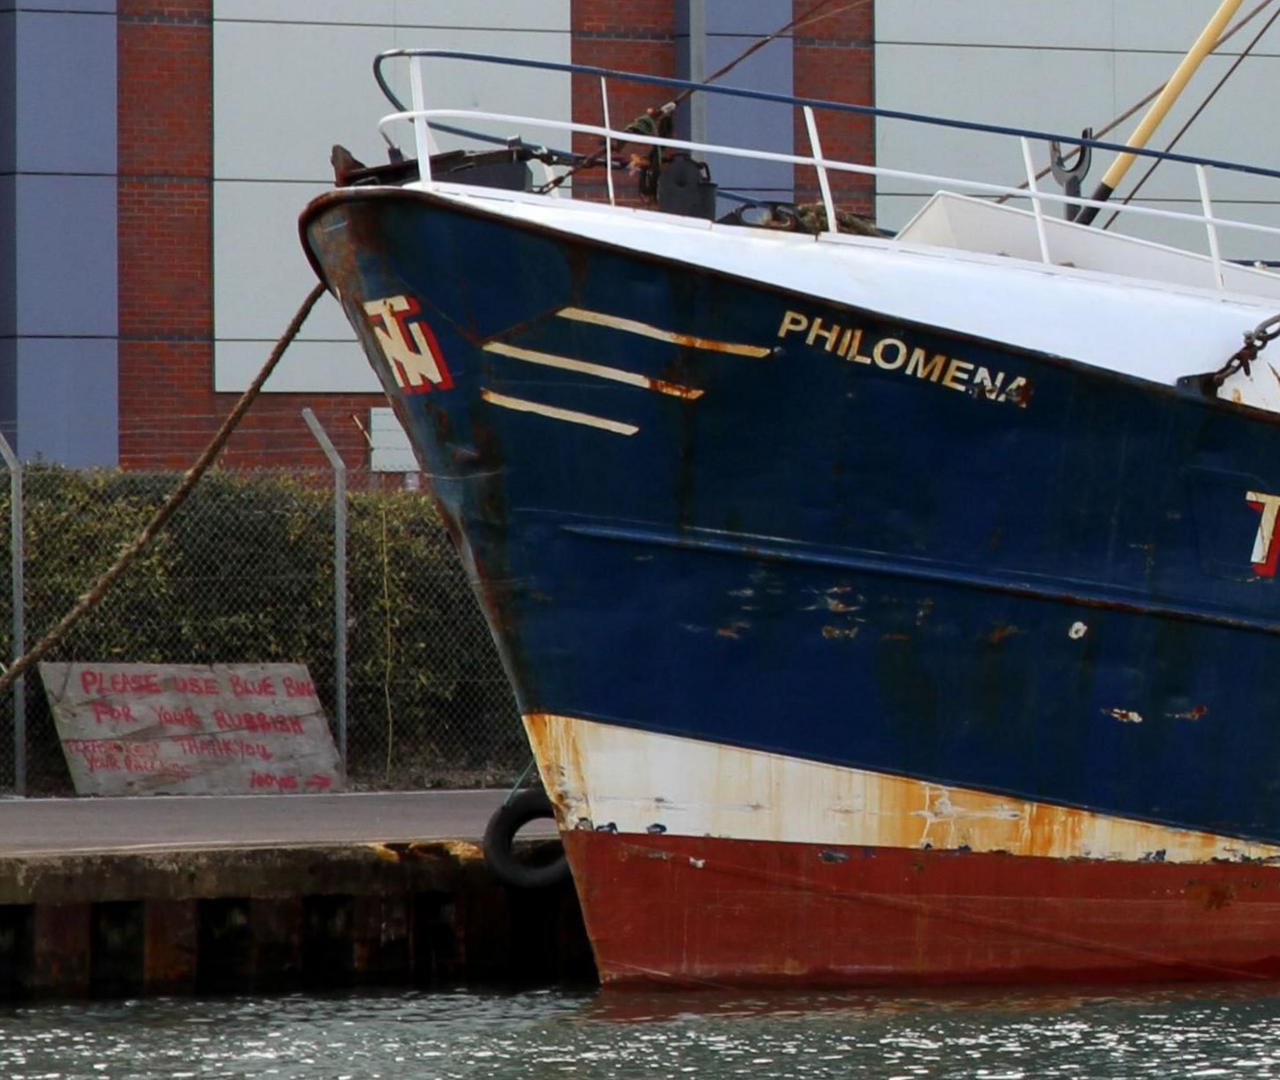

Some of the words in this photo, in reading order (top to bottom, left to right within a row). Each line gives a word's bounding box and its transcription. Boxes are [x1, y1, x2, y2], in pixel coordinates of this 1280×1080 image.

[81, 670, 162, 696] PLEASE
[174, 675, 220, 695] USE
[230, 674, 277, 697] BLUE
[91, 700, 137, 724] FOR
[213, 710, 304, 736] RUBBISH
